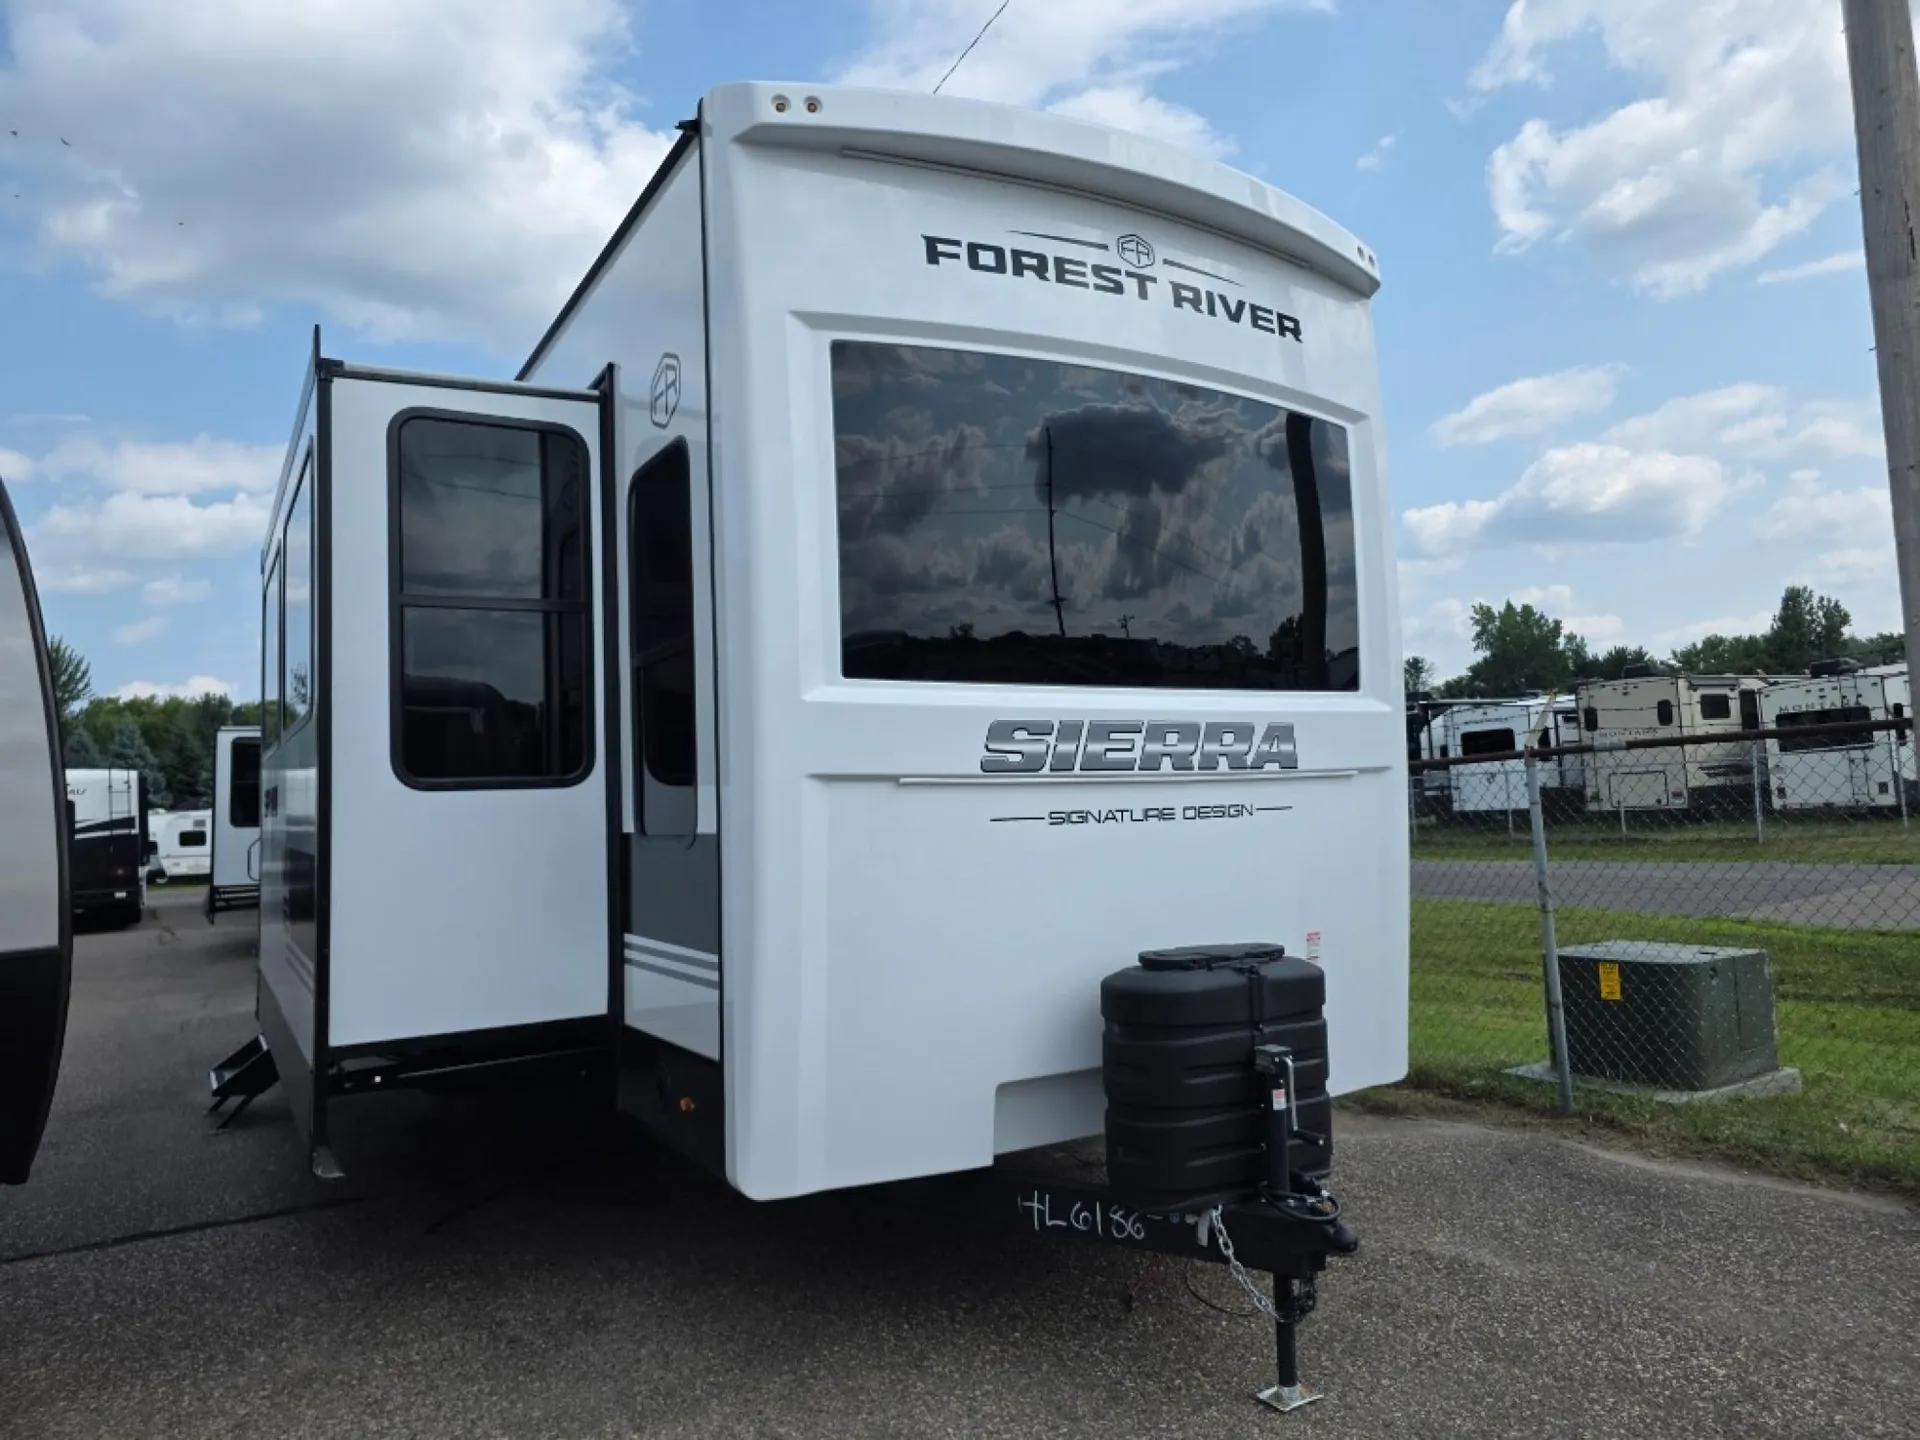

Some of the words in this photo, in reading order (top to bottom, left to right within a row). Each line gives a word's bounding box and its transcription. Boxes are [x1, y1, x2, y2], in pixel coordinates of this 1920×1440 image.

[920, 233, 1158, 301] FOREST
[1168, 280, 1304, 344] RIVER
[980, 719, 1299, 773] SIERRA
[1048, 807, 1176, 826] SIGNATURE
[1182, 803, 1254, 820] DESIGN
